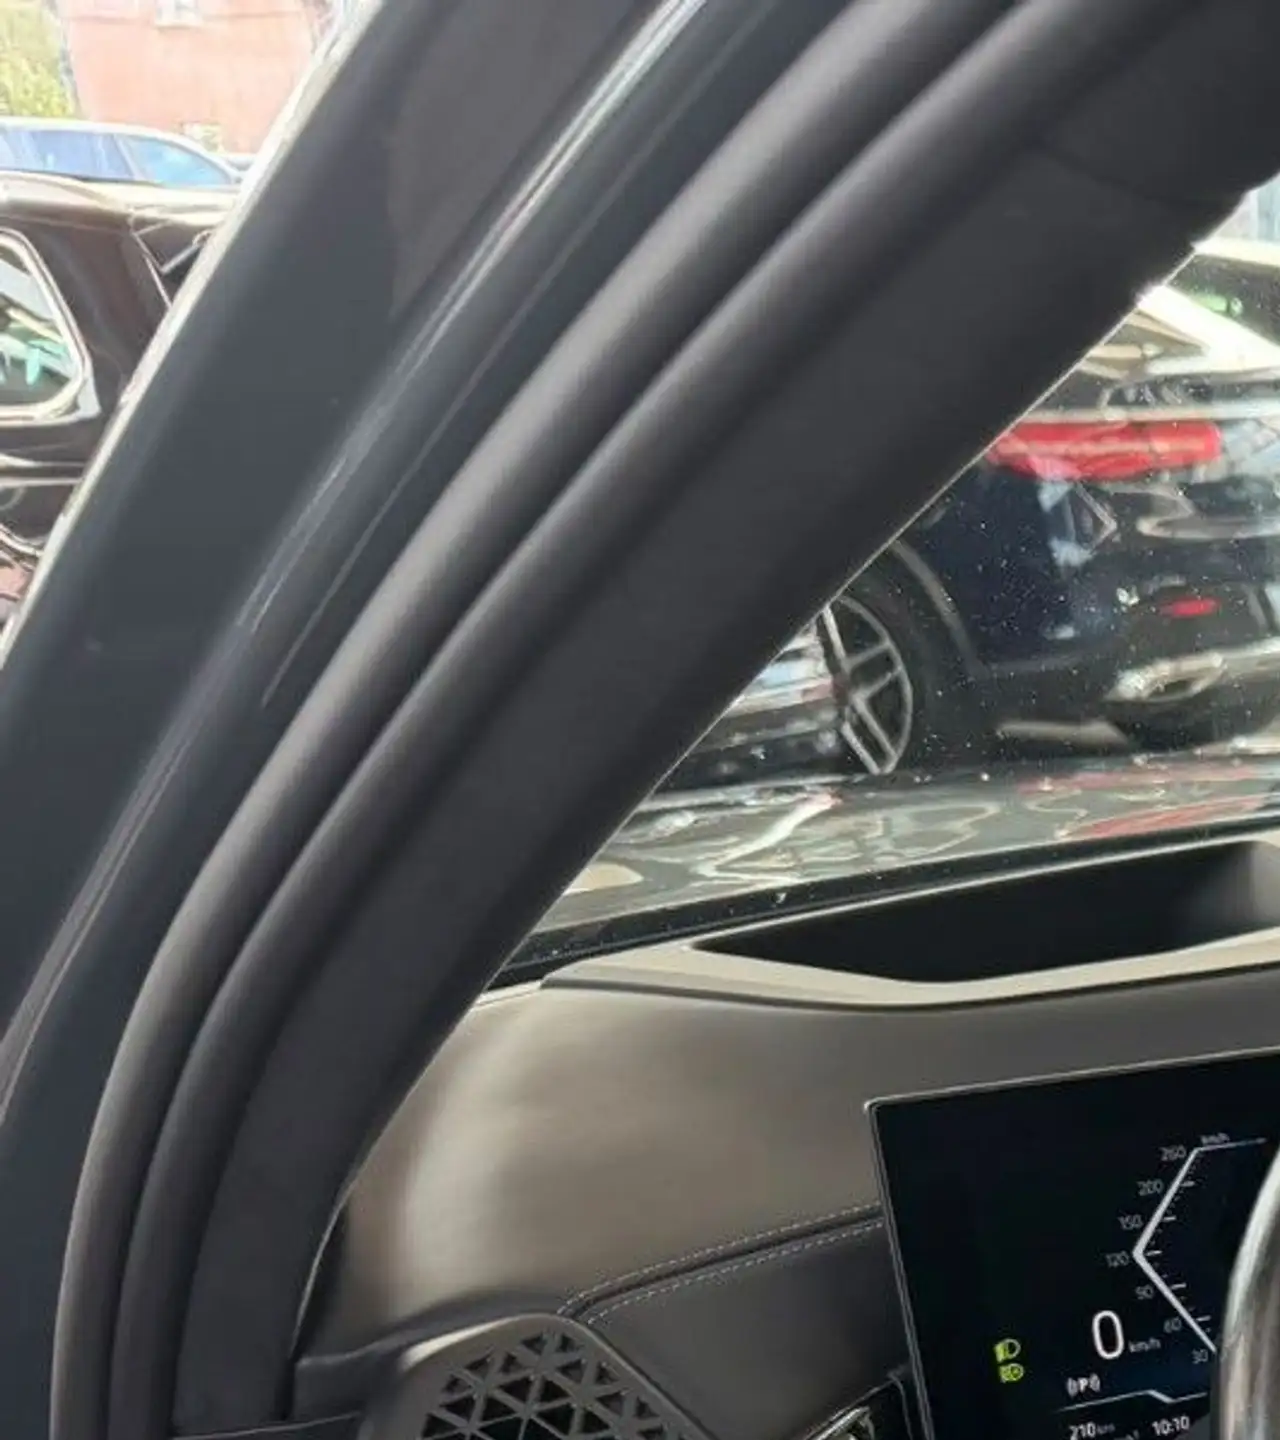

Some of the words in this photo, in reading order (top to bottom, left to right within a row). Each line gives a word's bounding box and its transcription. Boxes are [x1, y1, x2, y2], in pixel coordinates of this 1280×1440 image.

[1091, 1310, 1125, 1360] 0
[1069, 1423, 1097, 1440] 210
[1152, 1416, 1190, 1436] 10:10
